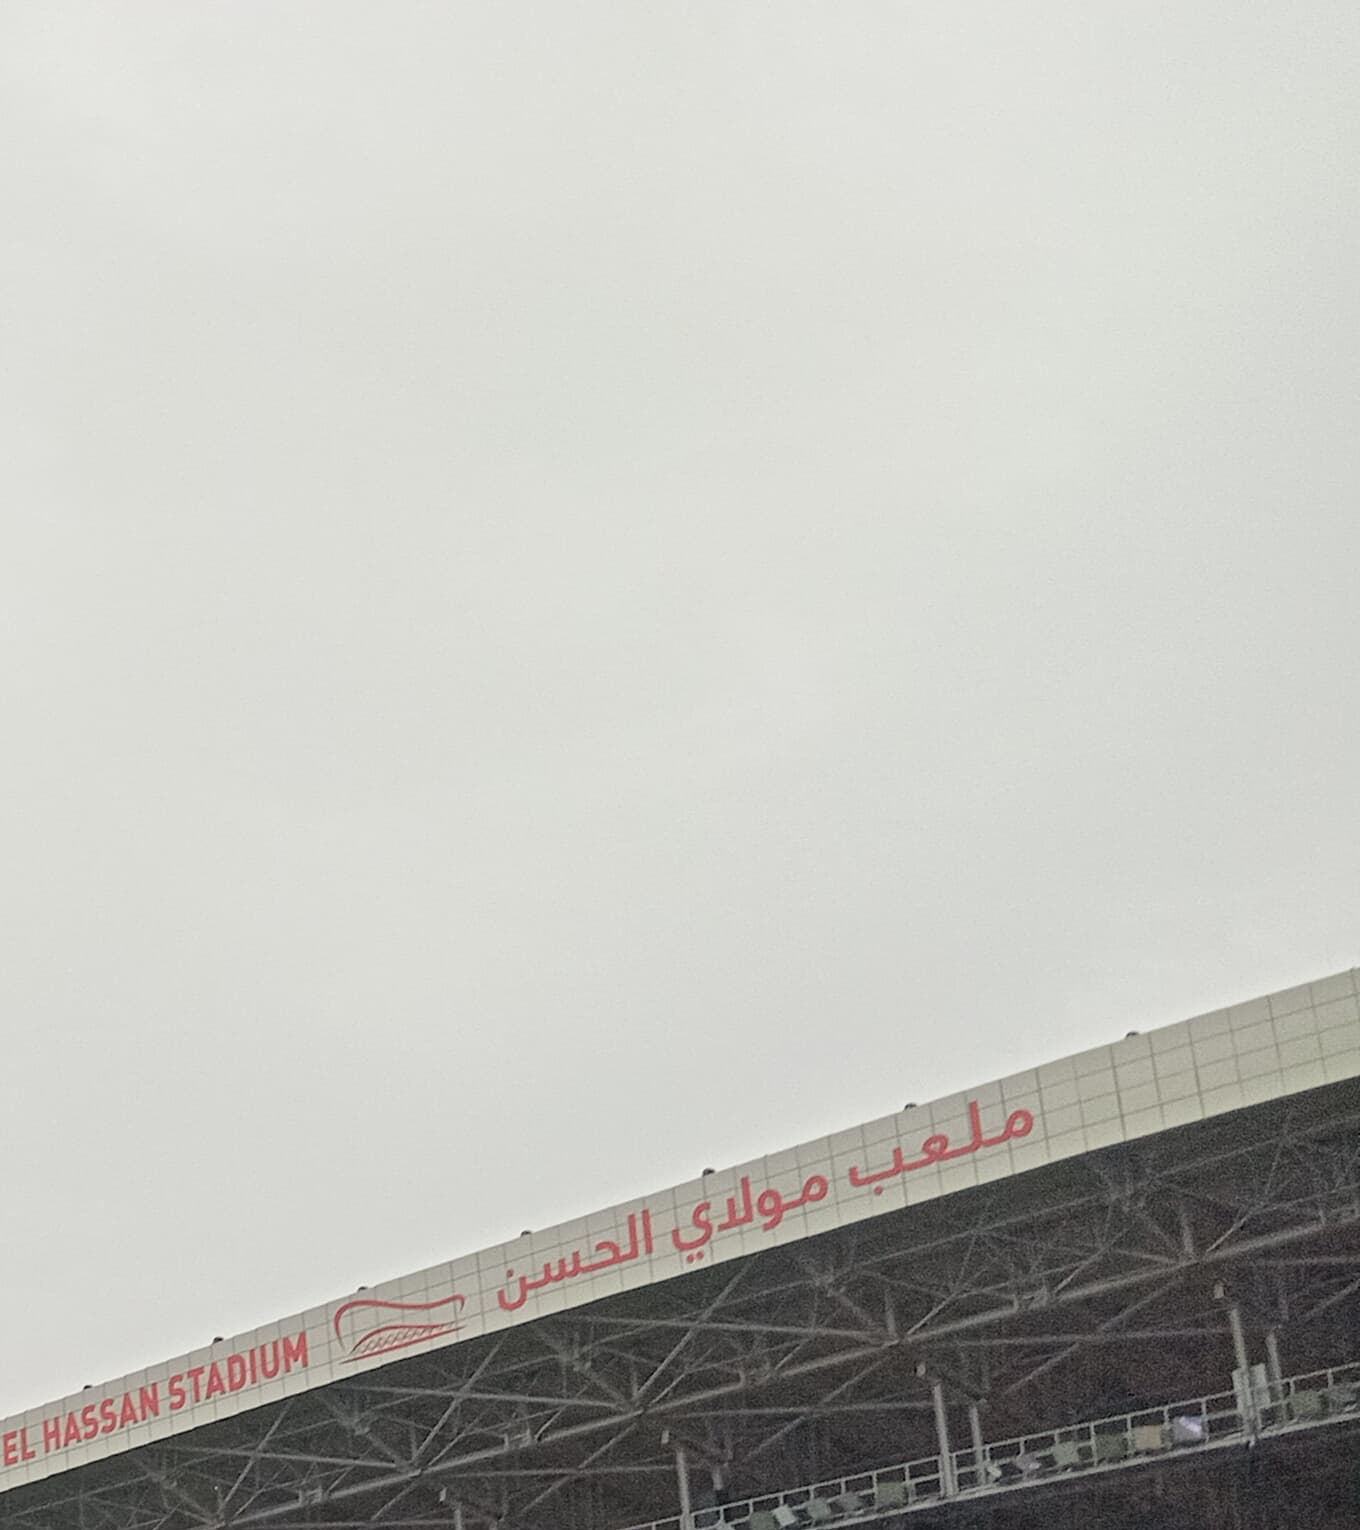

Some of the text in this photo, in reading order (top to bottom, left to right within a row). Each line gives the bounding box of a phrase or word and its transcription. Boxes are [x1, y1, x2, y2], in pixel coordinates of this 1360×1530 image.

[497, 1100, 1035, 1311] ملعب مولاي الحسن
[3, 1430, 36, 1466] EL
[43, 1382, 160, 1452] HASSAN
[168, 1332, 309, 1410] STADIUM
